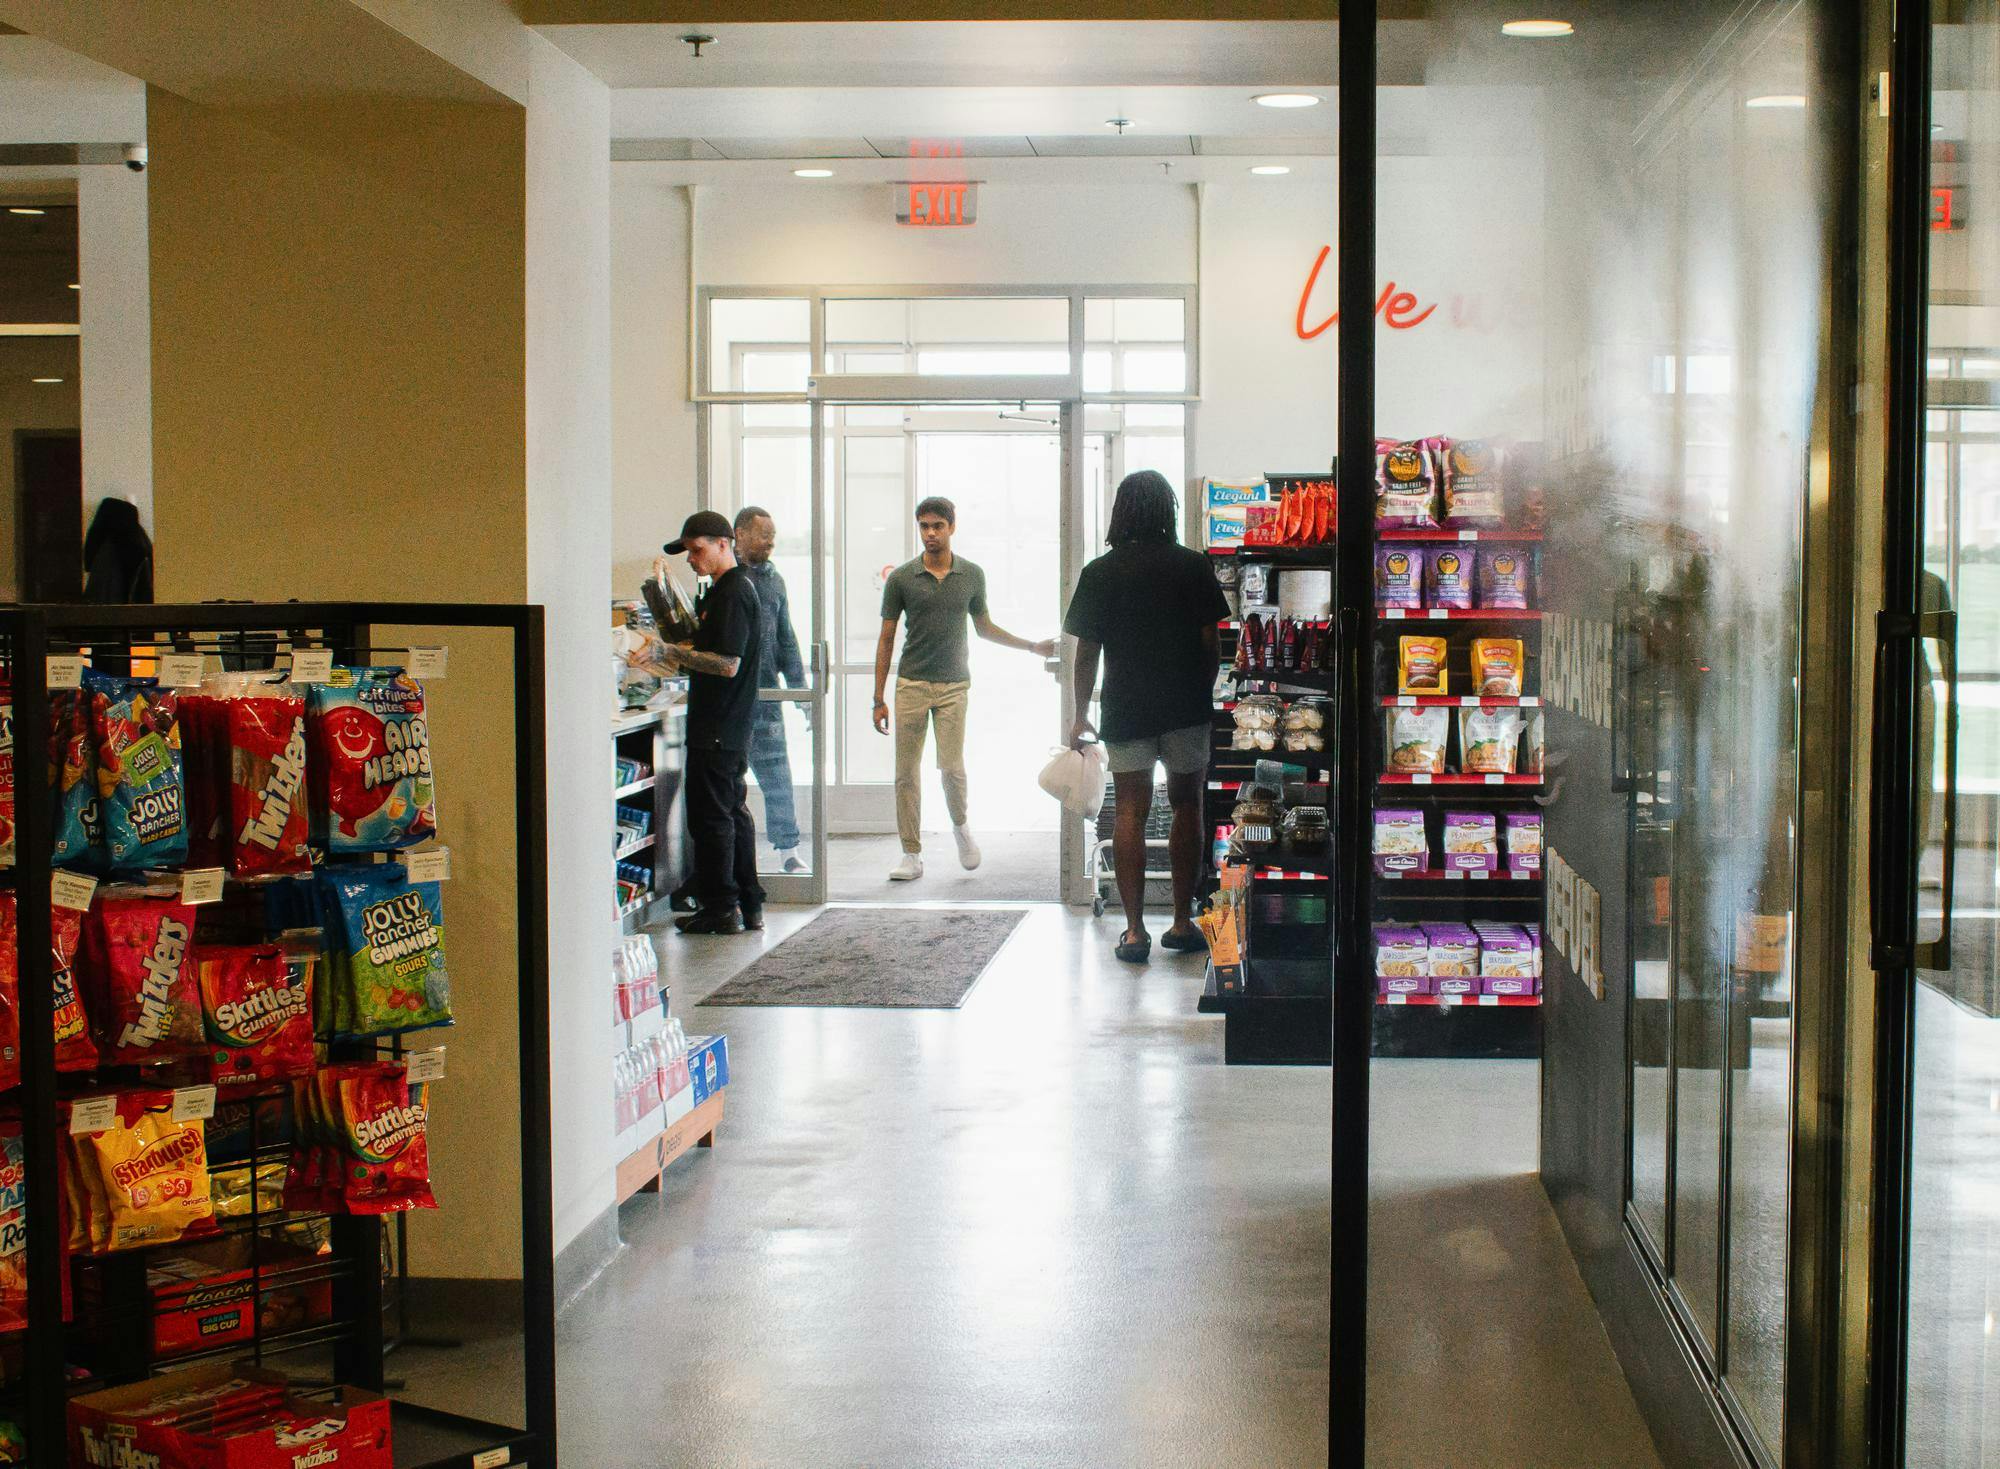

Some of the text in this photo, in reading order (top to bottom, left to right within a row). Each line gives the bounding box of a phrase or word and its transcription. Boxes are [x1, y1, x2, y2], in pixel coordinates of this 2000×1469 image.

[908, 183, 968, 225] EXIT
[1214, 490, 1260, 504] Elegant
[359, 688, 417, 703] soft filled
[375, 702, 405, 714] bites
[386, 719, 427, 752] AIR
[133, 745, 156, 767] JOLLY
[364, 747, 431, 789] HEADS
[134, 788, 179, 820] JOLLY
[140, 814, 181, 836] RANCHER
[364, 891, 421, 934] JOLLY
[371, 912, 431, 947] rancher
[370, 928, 439, 965] GUMMIES
[394, 956, 428, 977] SOURS
[158, 1003, 176, 1041] nibs
[215, 985, 307, 1031] Skittles
[239, 1002, 308, 1038] Gummies
[356, 1105, 425, 1147] Skittles
[373, 1121, 426, 1154] Gummies
[115, 1130, 201, 1186] Starburst
[200, 1311, 239, 1325] CARAMEL
[202, 1319, 239, 1334] BIG CUP
